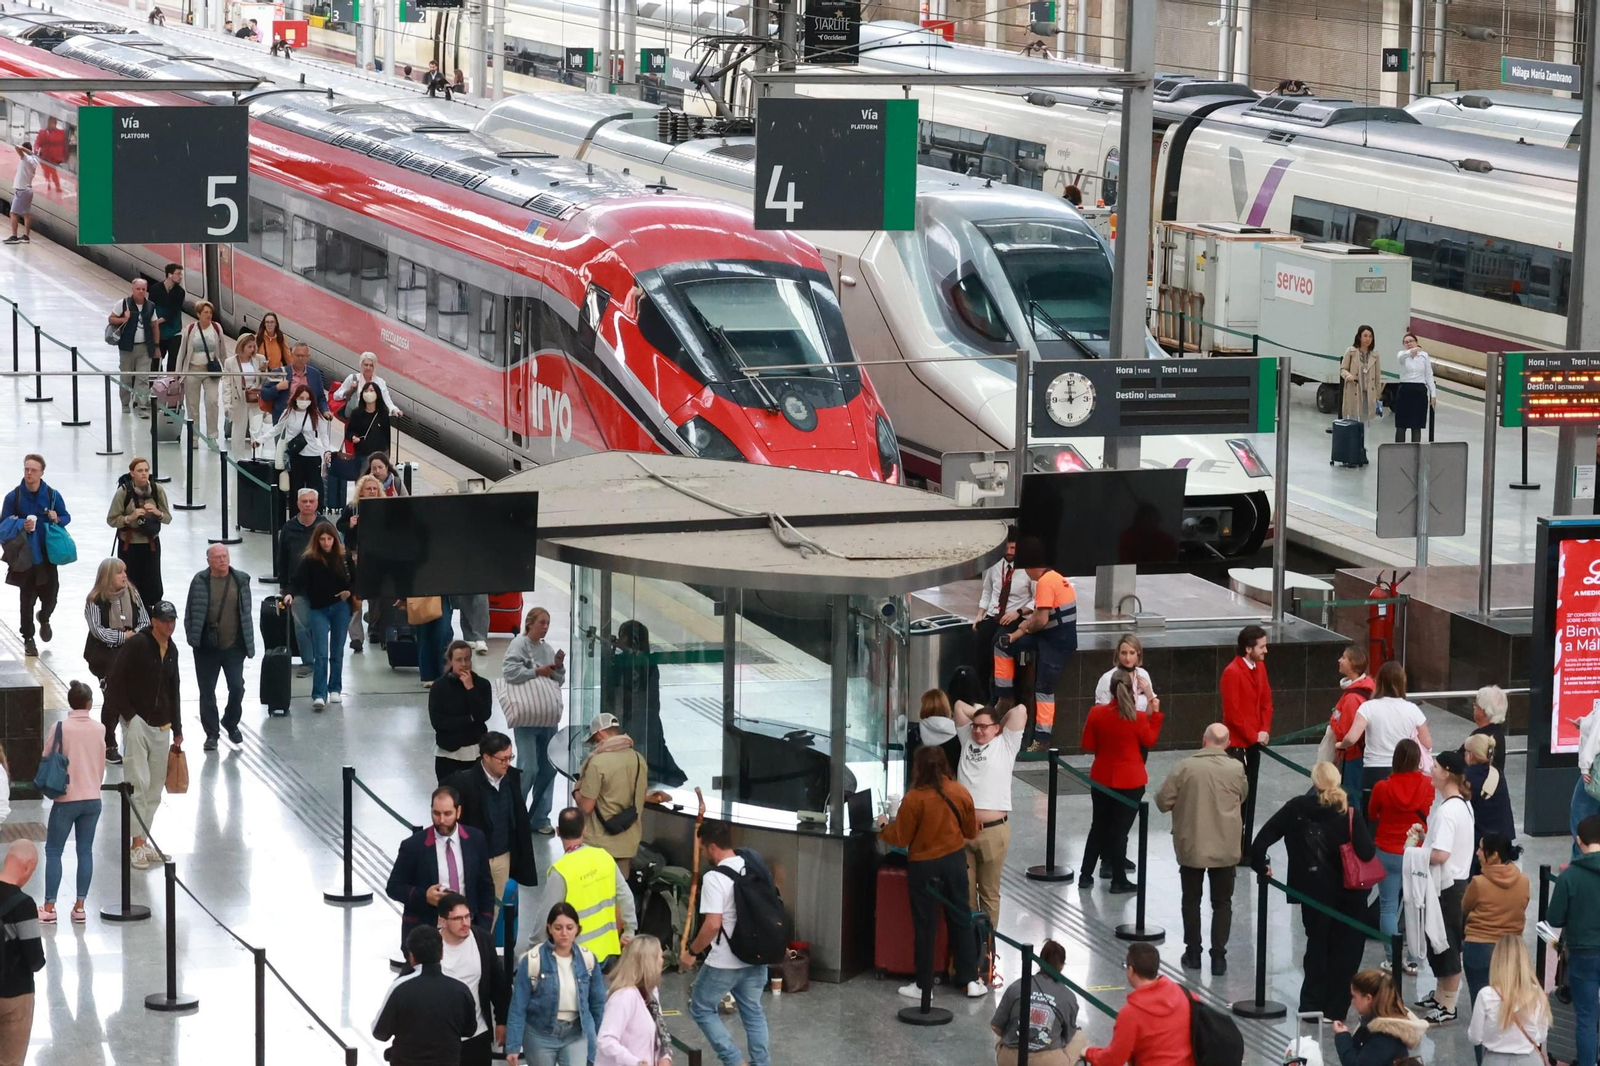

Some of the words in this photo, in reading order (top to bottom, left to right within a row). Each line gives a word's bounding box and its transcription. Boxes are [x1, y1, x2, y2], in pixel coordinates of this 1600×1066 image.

[333, 10, 340, 21] 3
[418, 11, 425, 23] 2
[1030, 11, 1037, 22] 1
[1511, 65, 1530, 80] Málaga
[1530, 68, 1546, 80] María
[1546, 69, 1573, 84] Zambrano
[861, 108, 879, 120] Vía
[121, 116, 140, 129] Vía
[764, 165, 804, 223] 4
[206, 175, 239, 237] 5
[1276, 271, 1313, 296] serveo
[1528, 358, 1545, 366] Hora
[1571, 357, 1587, 366] Tren
[1115, 366, 1134, 374] Hora
[1161, 365, 1178, 373] Tren
[1527, 382, 1554, 391] Destino
[1115, 391, 1144, 399] Destino
[531, 358, 573, 459] iryo
[1565, 641, 1573, 651] a
[1577, 639, 1600, 651] Mál
